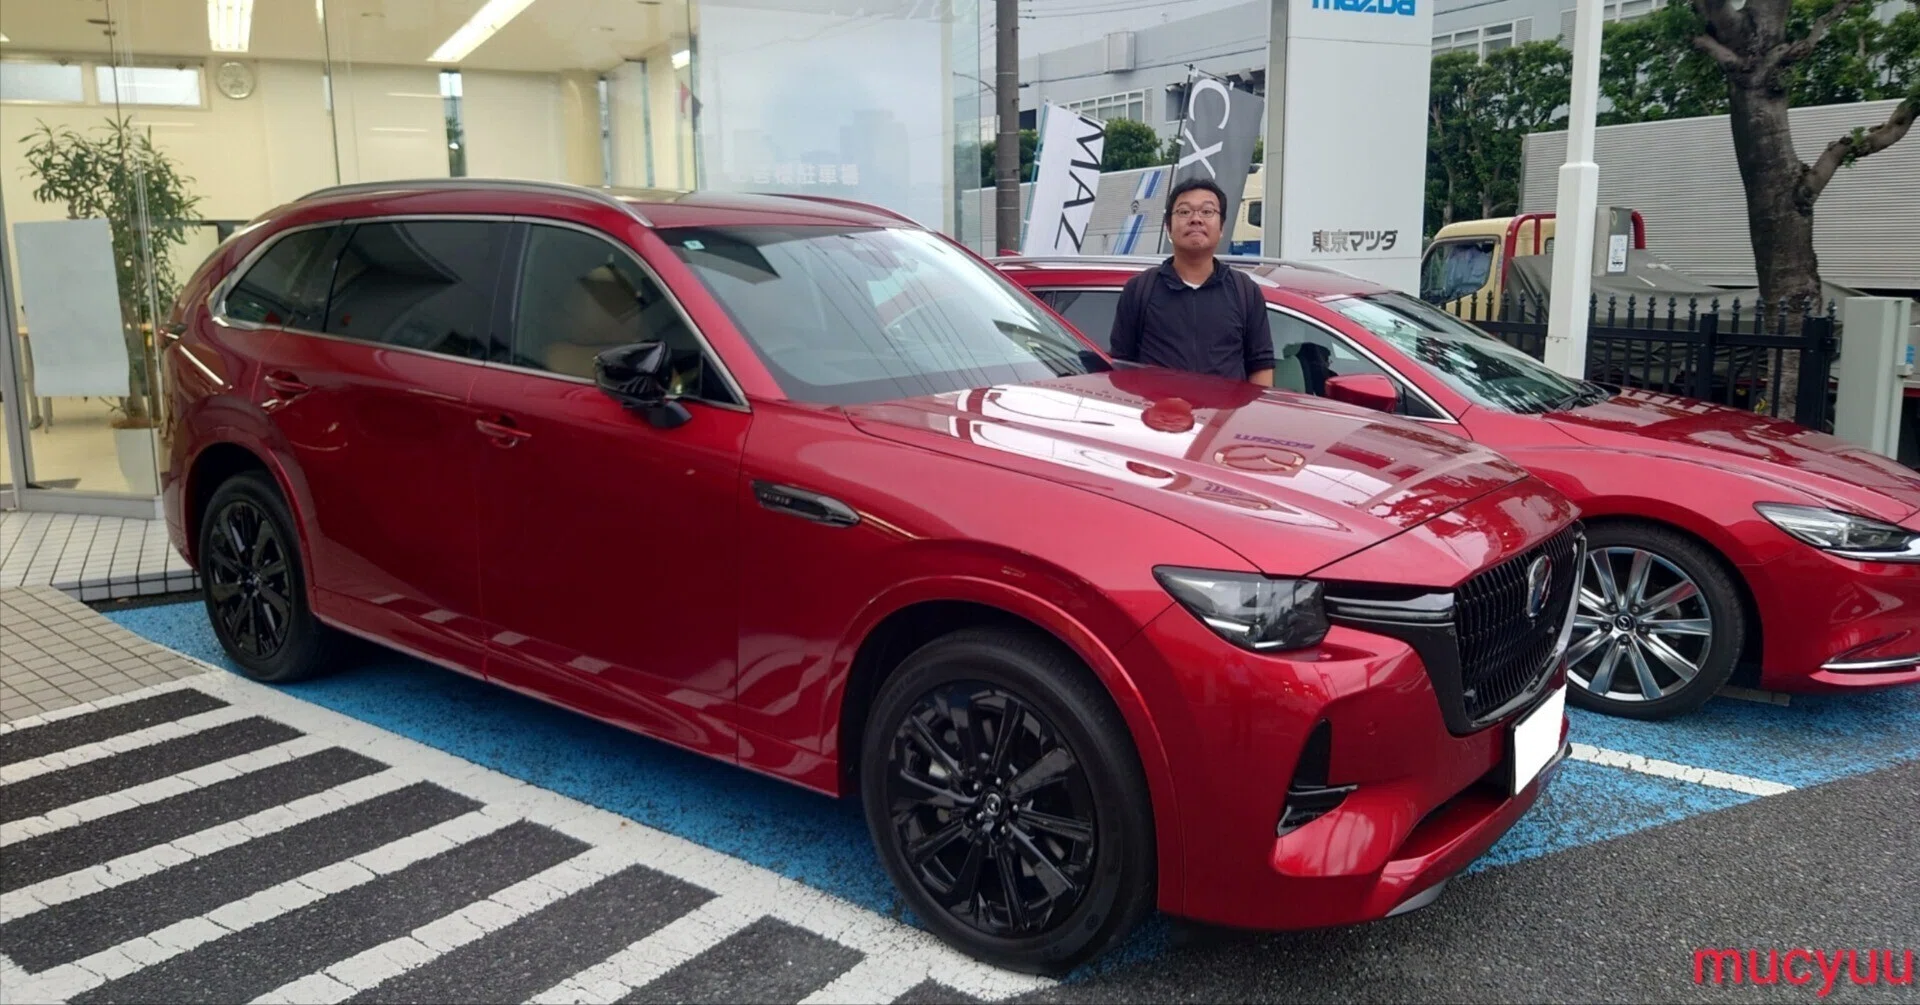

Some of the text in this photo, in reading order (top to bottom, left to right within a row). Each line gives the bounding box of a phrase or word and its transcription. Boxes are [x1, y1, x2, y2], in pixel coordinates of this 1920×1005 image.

[1311, 228, 1398, 253] 東京マツダ
